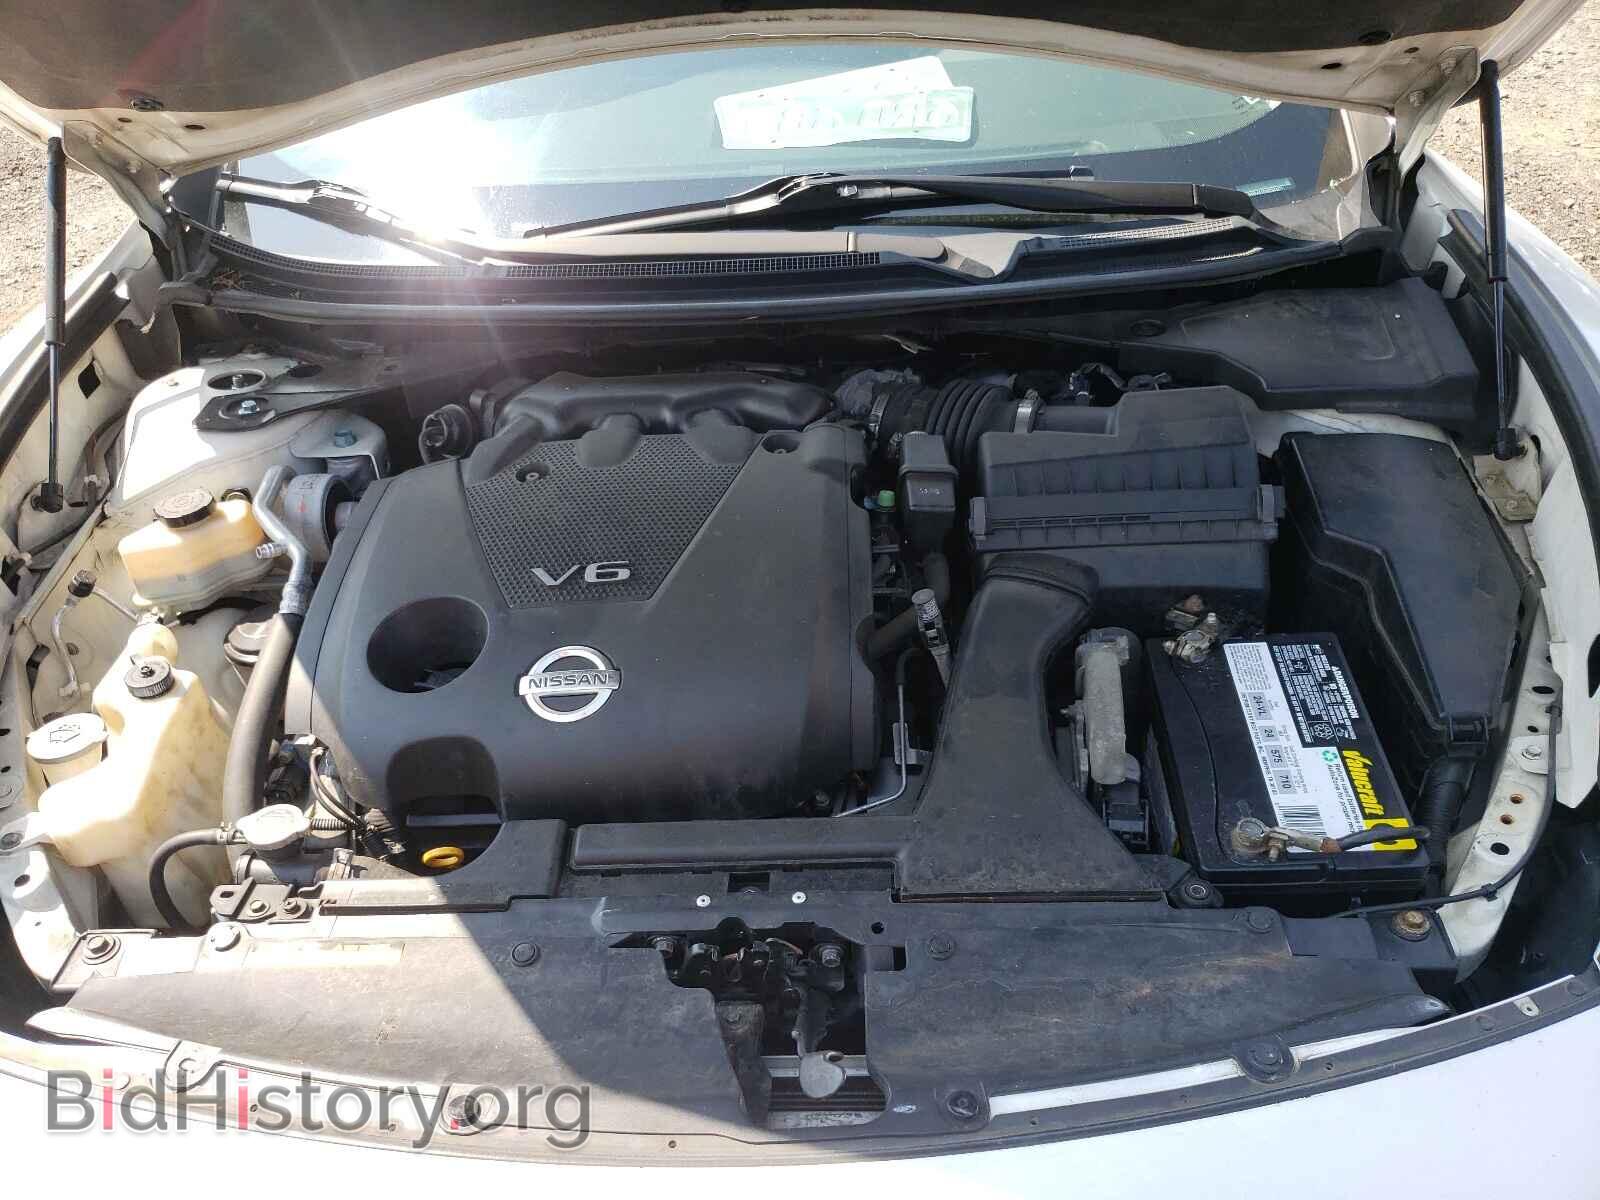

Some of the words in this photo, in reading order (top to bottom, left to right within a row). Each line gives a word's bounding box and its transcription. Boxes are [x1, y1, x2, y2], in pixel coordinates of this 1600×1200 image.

[530, 560, 631, 586] V6
[528, 673, 609, 689] NISSAN
[1271, 749, 1282, 763] 575
[1280, 775, 1291, 789] 710
[1343, 750, 1384, 815] Valucraft
